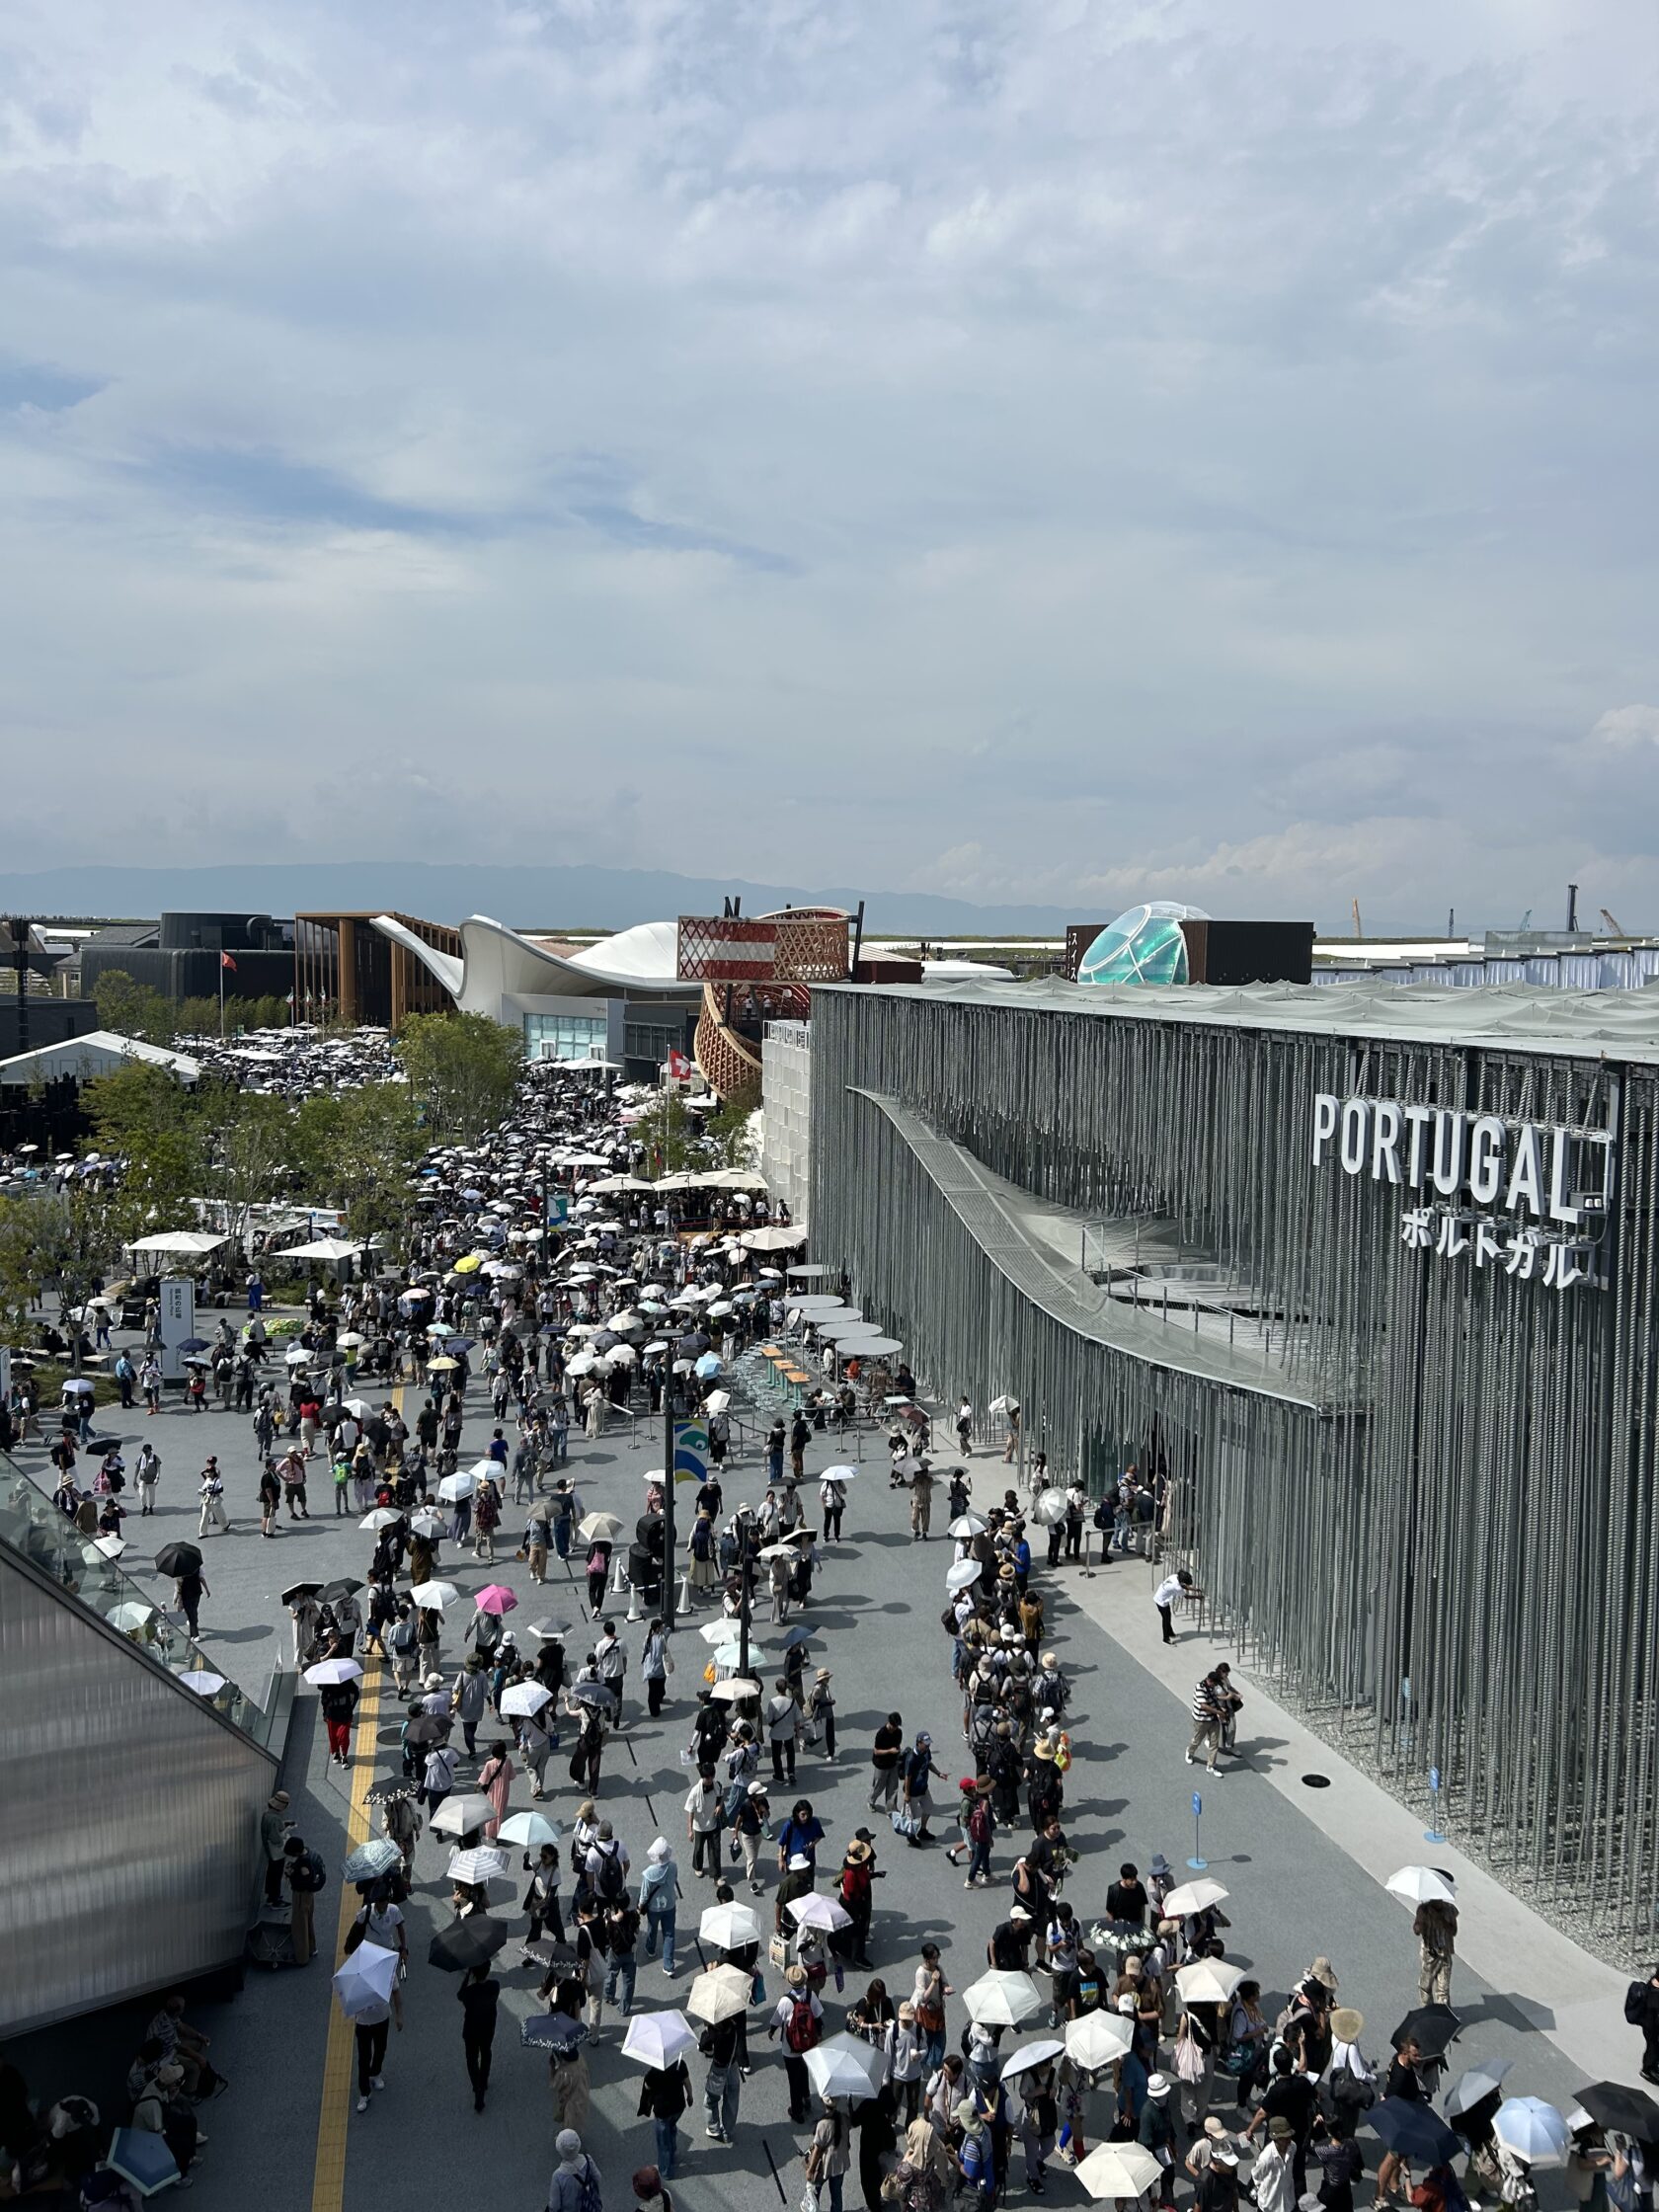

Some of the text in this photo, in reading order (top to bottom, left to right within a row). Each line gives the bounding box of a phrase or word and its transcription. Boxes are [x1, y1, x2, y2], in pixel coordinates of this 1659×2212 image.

[1312, 1093, 1584, 1224] PORTUGAL
[1401, 1208, 1583, 1290] ポルトガル
